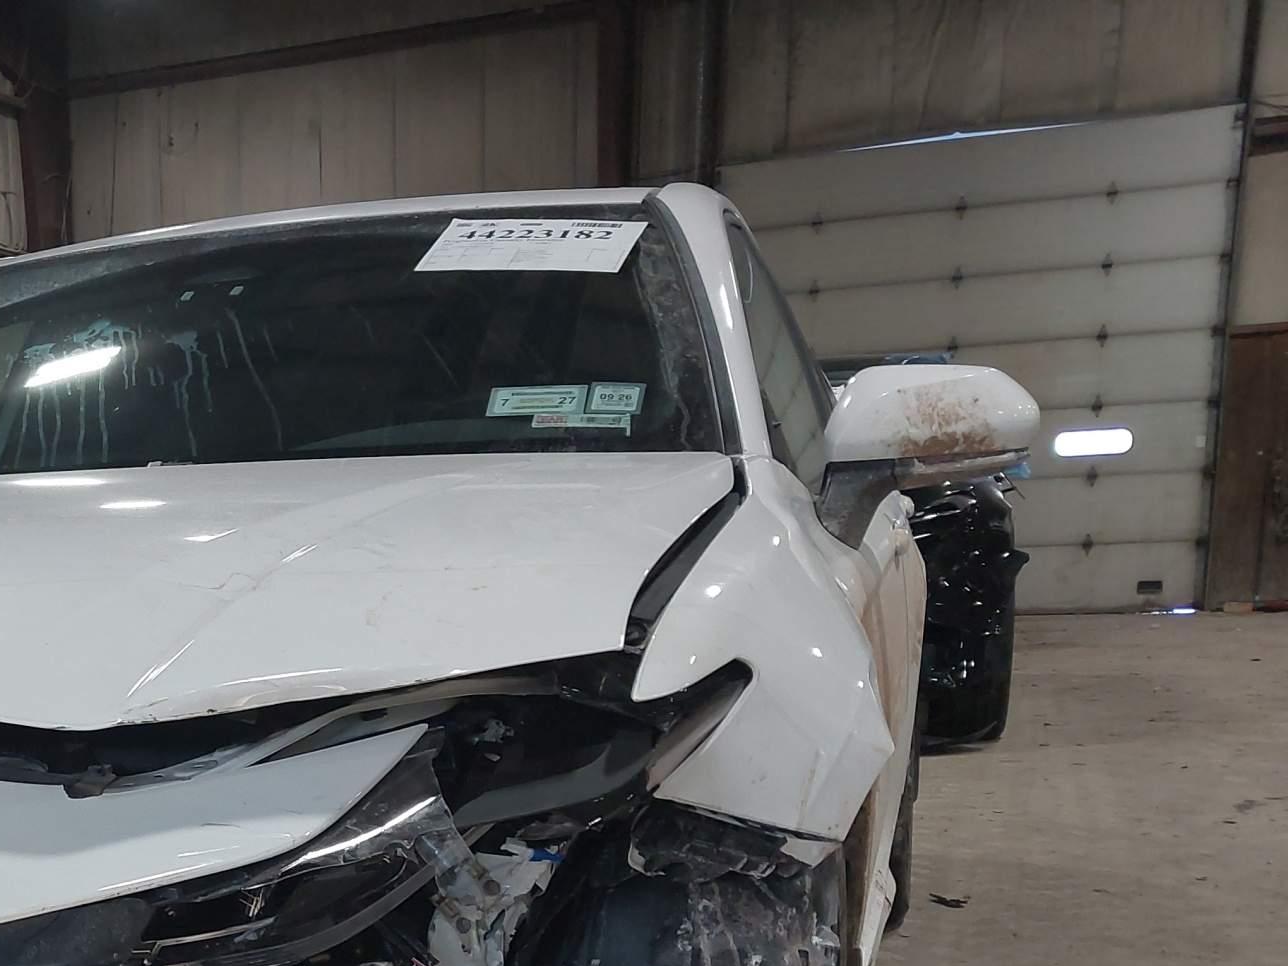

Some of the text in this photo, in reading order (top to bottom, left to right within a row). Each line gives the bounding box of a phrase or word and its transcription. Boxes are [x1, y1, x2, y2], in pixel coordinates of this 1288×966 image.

[458, 229, 614, 240] 44223182
[500, 398, 510, 407] 7
[558, 396, 577, 405] 27
